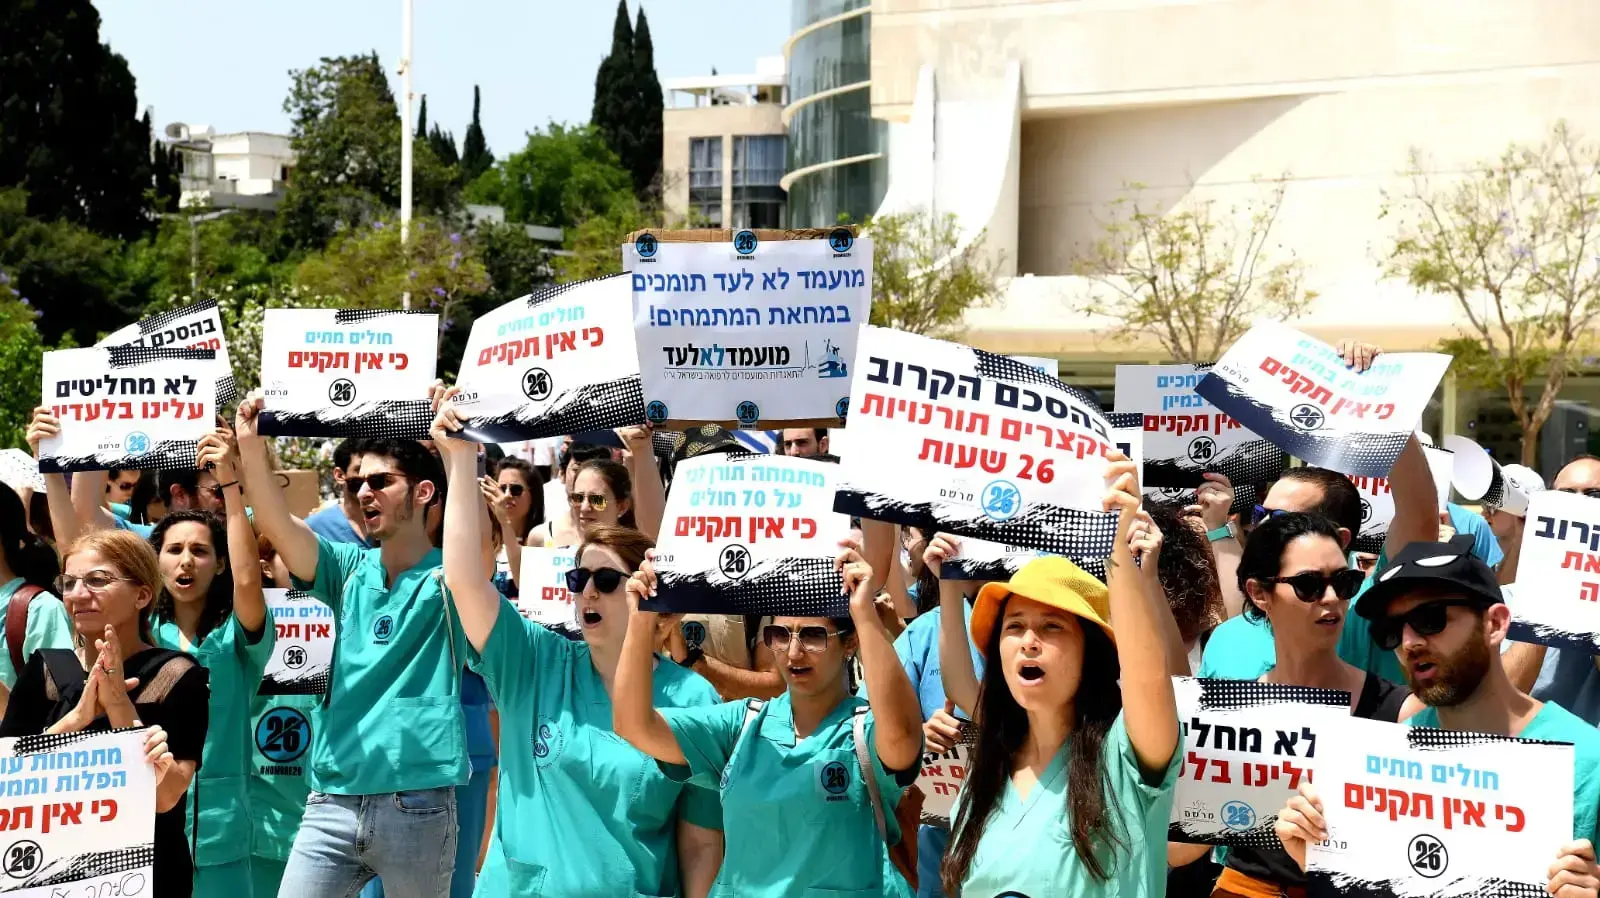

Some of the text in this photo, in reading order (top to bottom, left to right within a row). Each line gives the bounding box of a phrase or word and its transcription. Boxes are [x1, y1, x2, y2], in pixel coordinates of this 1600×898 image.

[632, 267, 865, 292] מועמד לא לעד תומכים
[497, 304, 585, 337] חולים מתים
[649, 304, 852, 327] במחאת המתמחים!
[151, 317, 217, 346] בהסכם
[305, 329, 393, 345] חולים מתים
[477, 326, 604, 366] כי אין תקנים
[288, 351, 409, 374] כי אין תקנים
[56, 374, 197, 398] לא מחליטים
[526, 372, 548, 396] 26
[867, 355, 982, 401] הקרוב
[1259, 356, 1334, 406] תקנים
[334, 383, 351, 401] 26
[1162, 393, 1203, 411] במיון
[142, 398, 204, 421] עלינו
[860, 393, 990, 435] תורנויות
[1293, 407, 1321, 428] 26
[1374, 402, 1396, 420] כי
[1143, 414, 1209, 437] תקנים
[918, 437, 1055, 484] 26 שעות
[1193, 441, 1212, 459] 26
[710, 465, 745, 485] תורן
[752, 465, 825, 488] מתמחה
[690, 488, 802, 508] על 70 חולים
[939, 487, 975, 502] מרשם
[674, 516, 817, 543] כי אין תקנים
[725, 550, 746, 573] 26
[305, 623, 330, 642] אין
[287, 650, 303, 665] 26
[265, 715, 301, 753] 26
[1179, 717, 1317, 758] לא מחלי
[30, 746, 122, 772] מתמחות
[55, 770, 127, 793] הפלות
[1242, 760, 1313, 790] לינו
[1366, 753, 1500, 791] חולים מתים
[41, 801, 83, 834] אין
[91, 799, 118, 823] כי
[1184, 809, 1215, 820] מרשם
[1227, 805, 1250, 826] 26
[1344, 782, 1526, 833] כי אין תקנים
[10, 845, 36, 872] 26
[1413, 840, 1441, 871] 26
